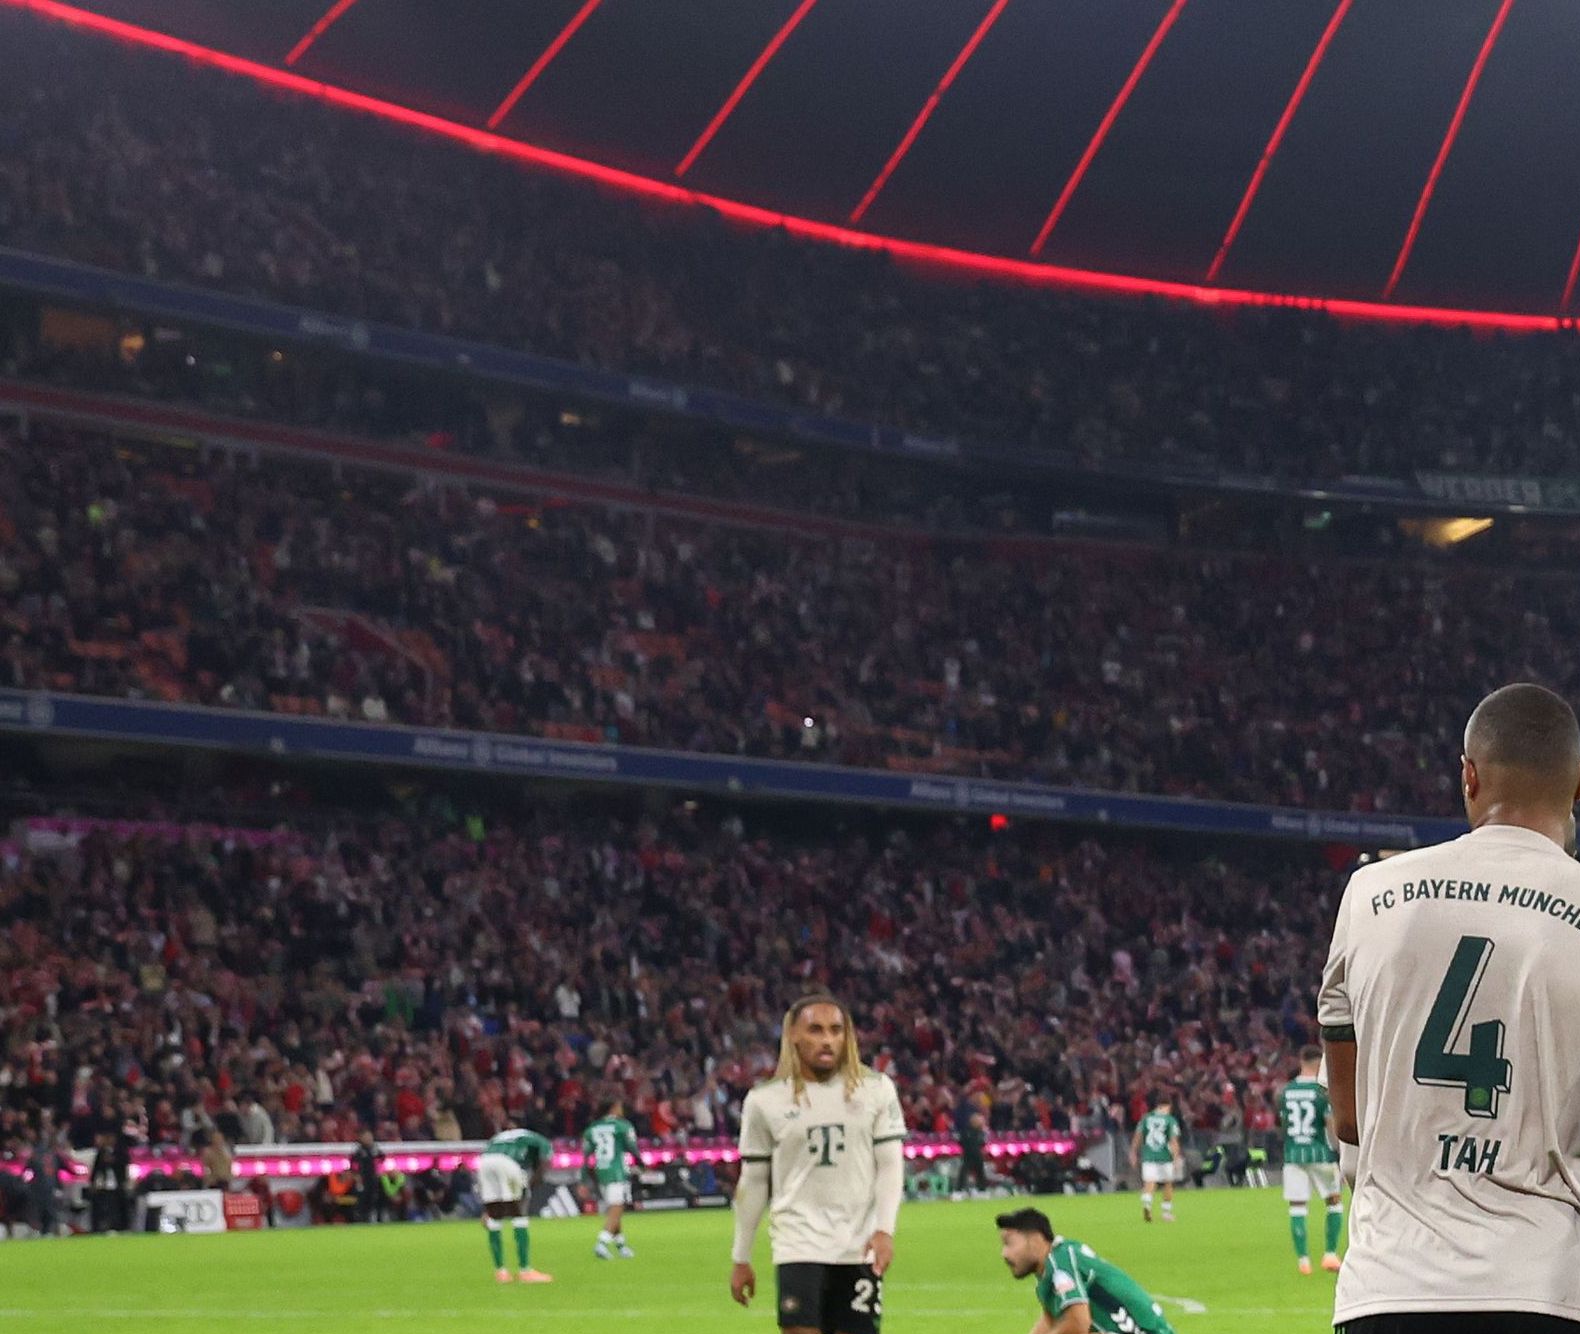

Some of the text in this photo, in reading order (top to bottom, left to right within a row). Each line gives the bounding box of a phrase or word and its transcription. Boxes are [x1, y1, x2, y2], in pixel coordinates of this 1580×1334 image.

[1372, 888, 1396, 916] FC
[1402, 879, 1491, 904] BAYERN
[1412, 935, 1513, 1120] 4
[1286, 1101, 1317, 1137] 32
[1438, 1134, 1501, 1176] TAH
